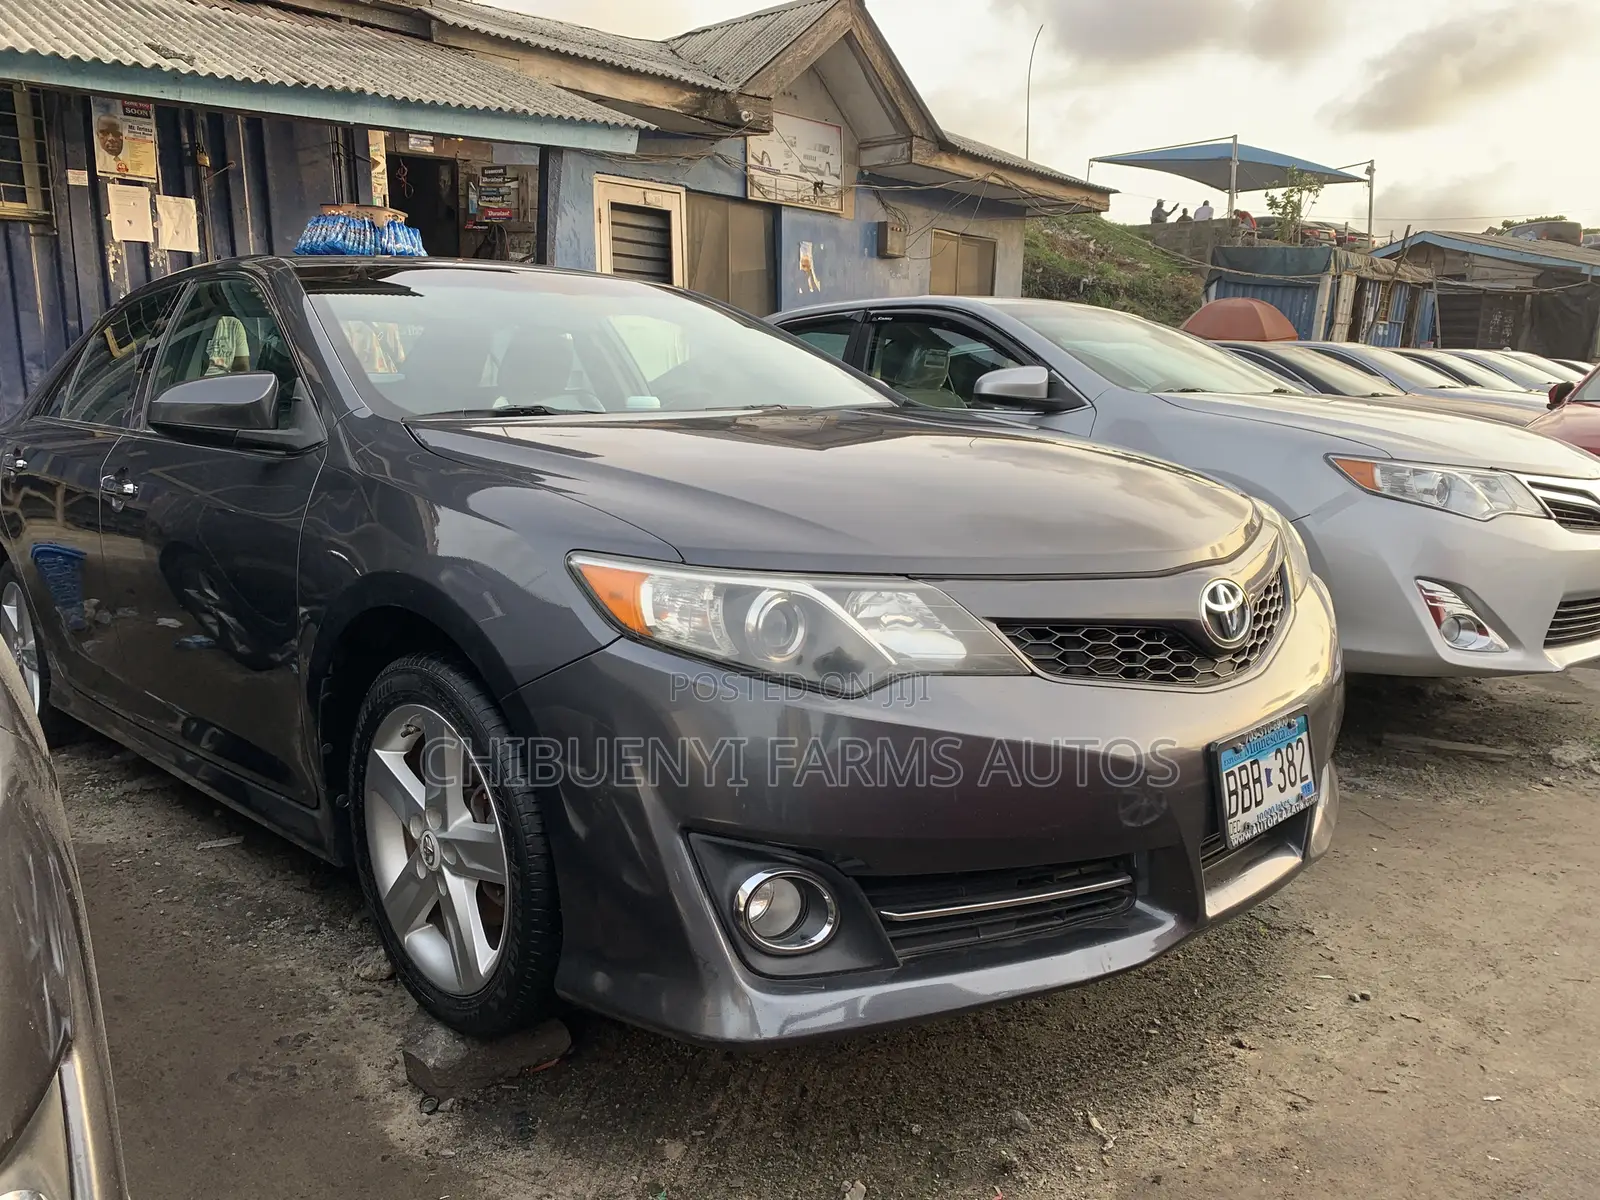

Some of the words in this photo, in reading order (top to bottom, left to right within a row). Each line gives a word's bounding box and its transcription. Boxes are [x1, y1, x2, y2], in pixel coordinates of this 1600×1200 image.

[125, 107, 149, 117] SOON
[1225, 758, 1264, 820] BBB
[1274, 737, 1309, 794] 382
